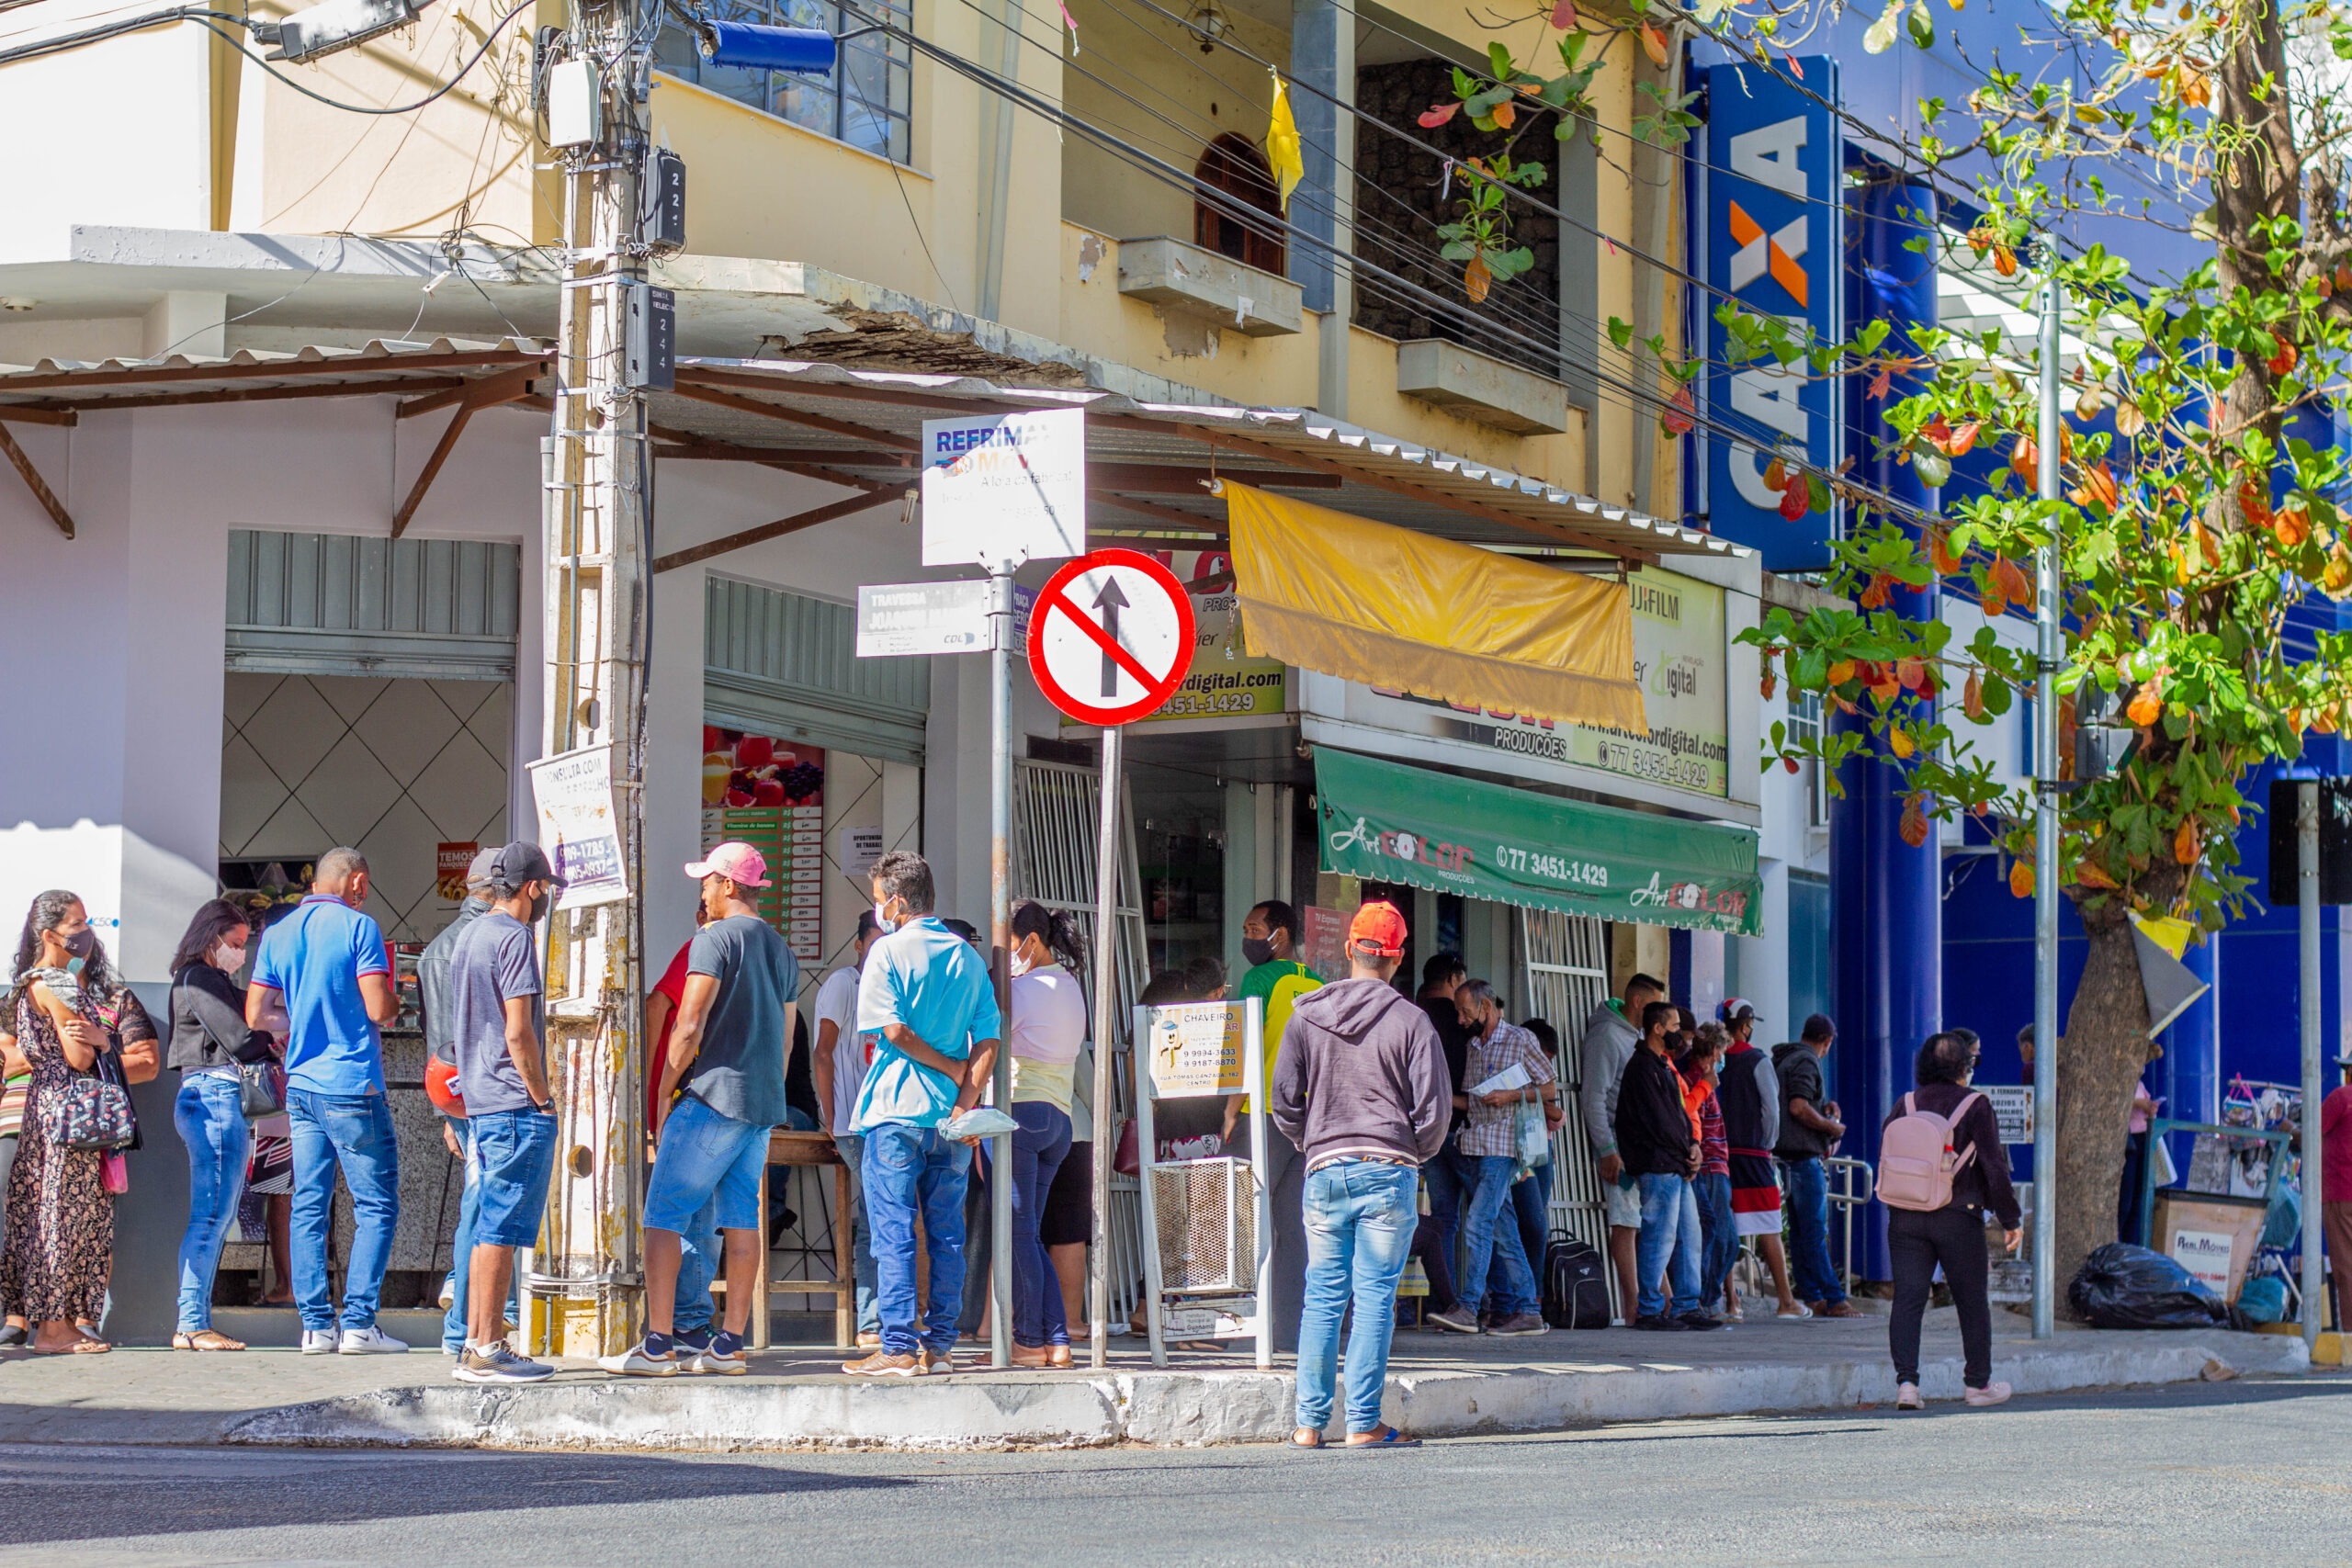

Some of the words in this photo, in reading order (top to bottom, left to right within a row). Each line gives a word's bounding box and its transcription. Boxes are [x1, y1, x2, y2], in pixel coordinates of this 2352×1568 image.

[1203, 596, 1235, 612] PRO
[1181, 671, 1282, 694] rdigital.com
[1494, 725, 1566, 761] PRODUÇÕES
[1611, 743, 1630, 772] 77
[1632, 748, 1709, 790] 3451-1429
[439, 852, 476, 862] TEMOS
[1508, 847, 1527, 873] 77
[1532, 852, 1608, 888] 3451-1429
[1437, 869, 1476, 885] PRODUÇÕES
[1183, 1012, 1234, 1023] CHAVEIRO
[1192, 1058, 1237, 1067] 9187-8870
